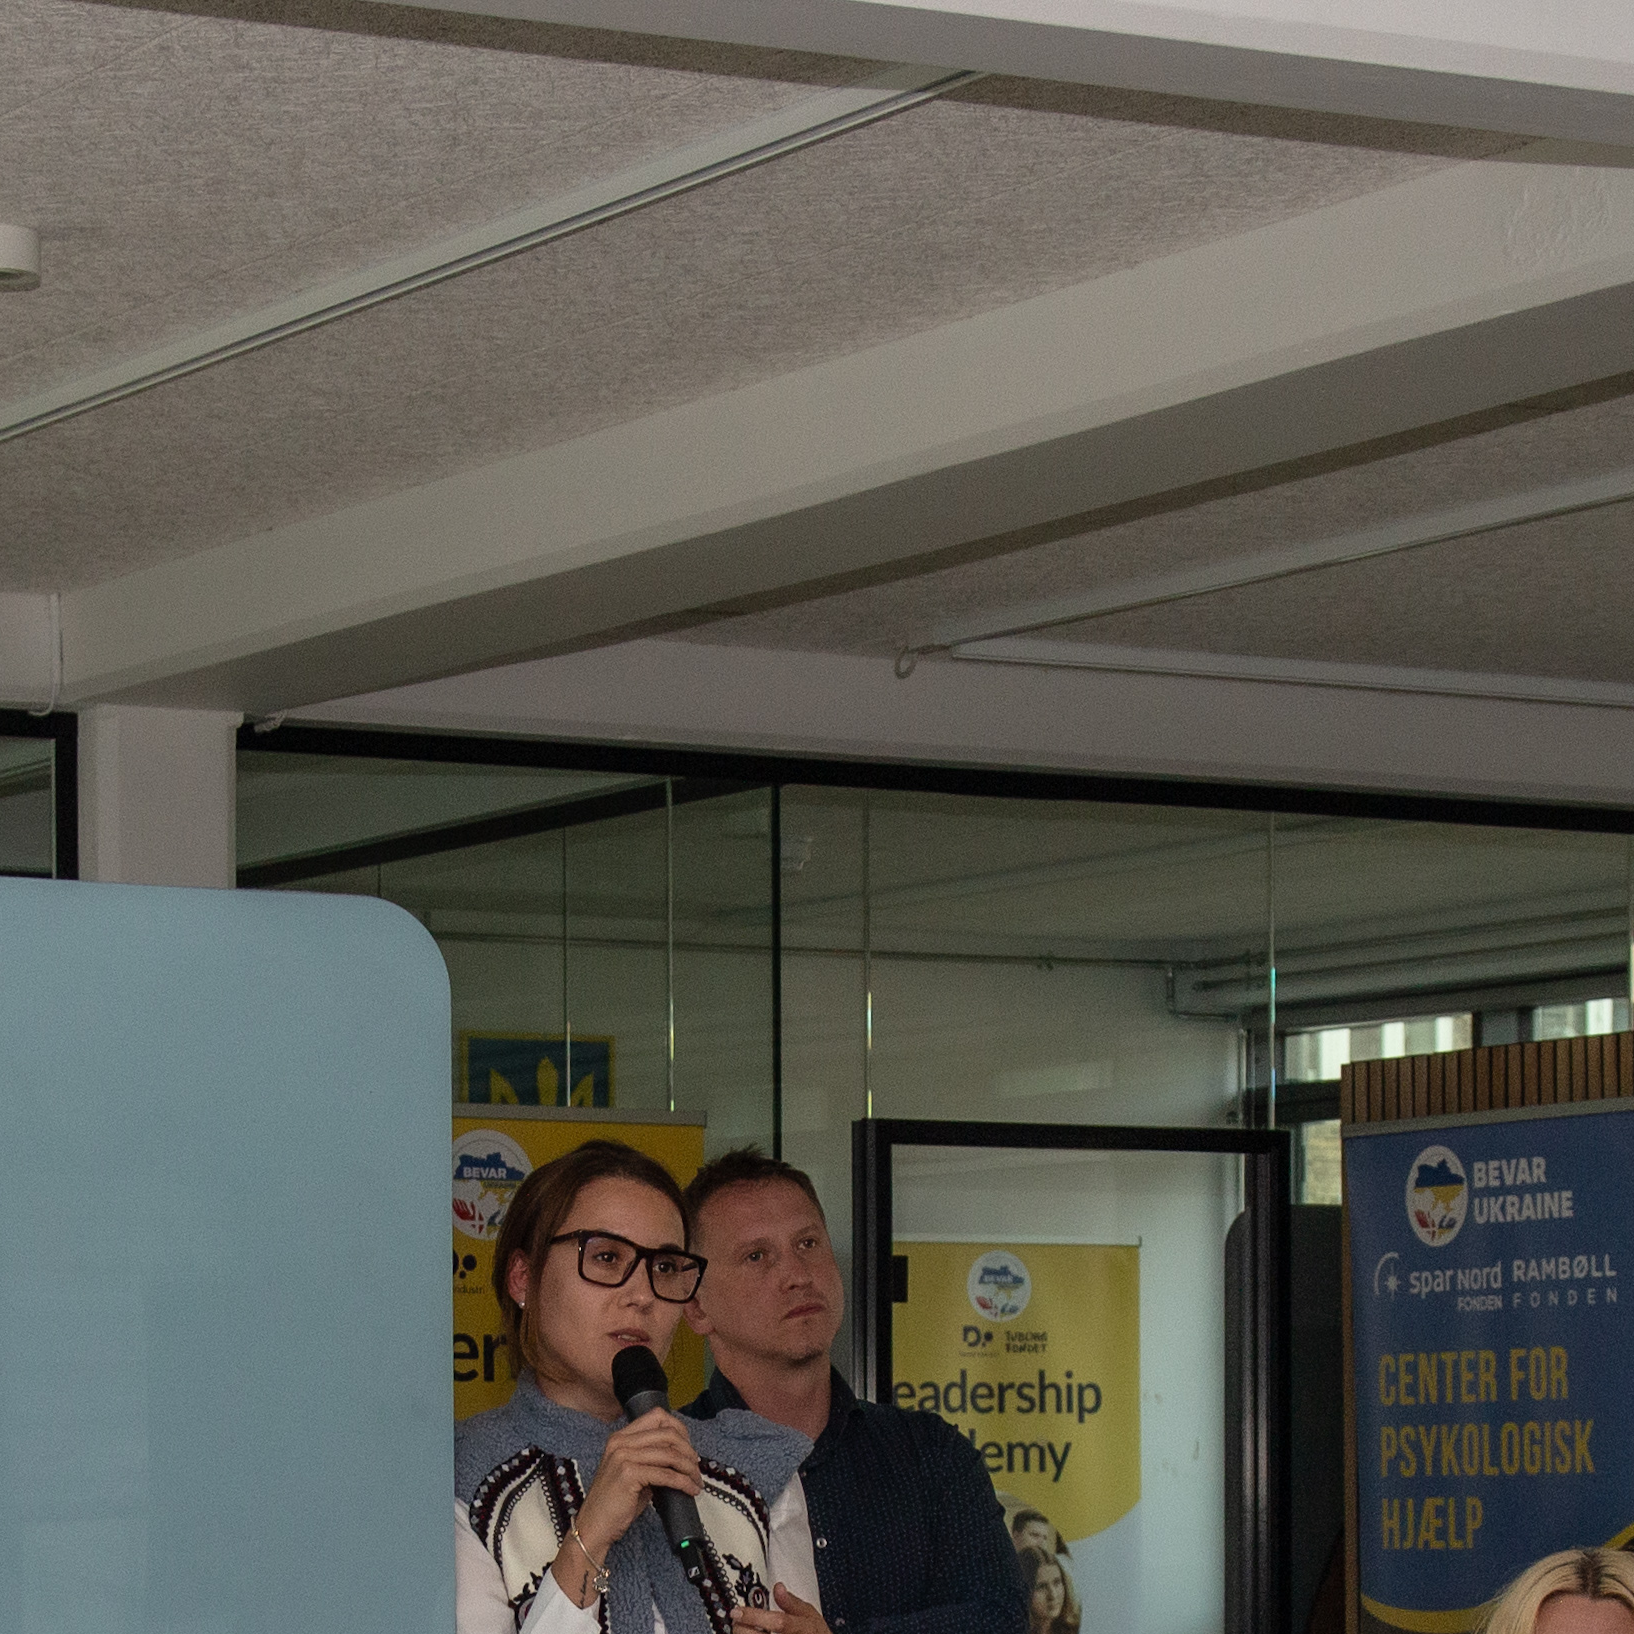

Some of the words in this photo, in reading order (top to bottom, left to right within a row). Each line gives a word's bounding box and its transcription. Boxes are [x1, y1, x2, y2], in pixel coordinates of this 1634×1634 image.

[462, 1166, 507, 1179] BEVAR
[1473, 1156, 1547, 1189] BEVAR
[1473, 1190, 1575, 1225] UKRAINE
[1512, 1253, 1618, 1283] RAMBØLL
[892, 1368, 1103, 1424] eadership
[1378, 1349, 1498, 1407] CENTER
[1509, 1346, 1570, 1401] FOR
[1380, 1418, 1596, 1478] PSYKOLOGISK
[1381, 1496, 1484, 1550] HJÆLP
